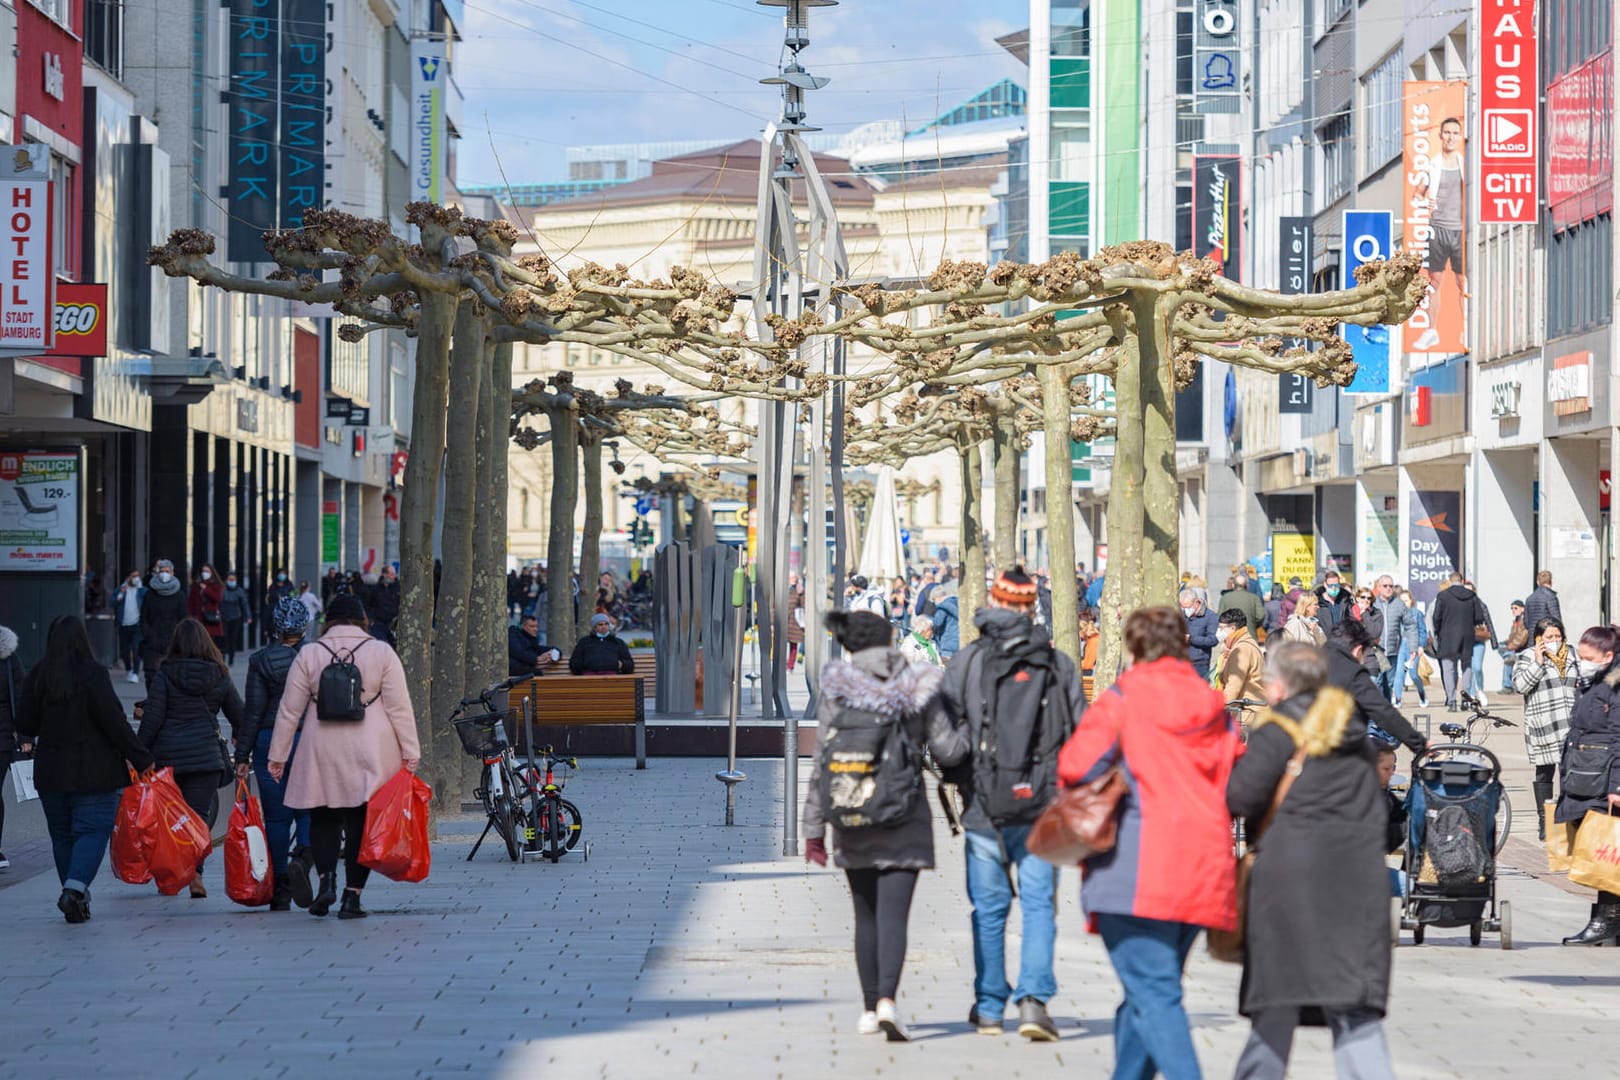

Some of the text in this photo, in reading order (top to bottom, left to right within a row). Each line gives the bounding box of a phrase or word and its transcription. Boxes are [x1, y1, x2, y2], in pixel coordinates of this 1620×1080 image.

[1494, 0, 1522, 98] AUS
[1407, 103, 1431, 187] Sports
[1491, 143, 1526, 151] RADIO
[1207, 162, 1225, 250] Pizza Hut
[1493, 198, 1524, 218] TV
[11, 187, 32, 305] HOTEL
[5, 312, 34, 323] STADT
[55, 305, 96, 332] EGO
[22, 460, 74, 472] ENDLICH
[1411, 540, 1439, 553] Day
[1411, 554, 1451, 568] Night
[1411, 568, 1450, 582] Sport
